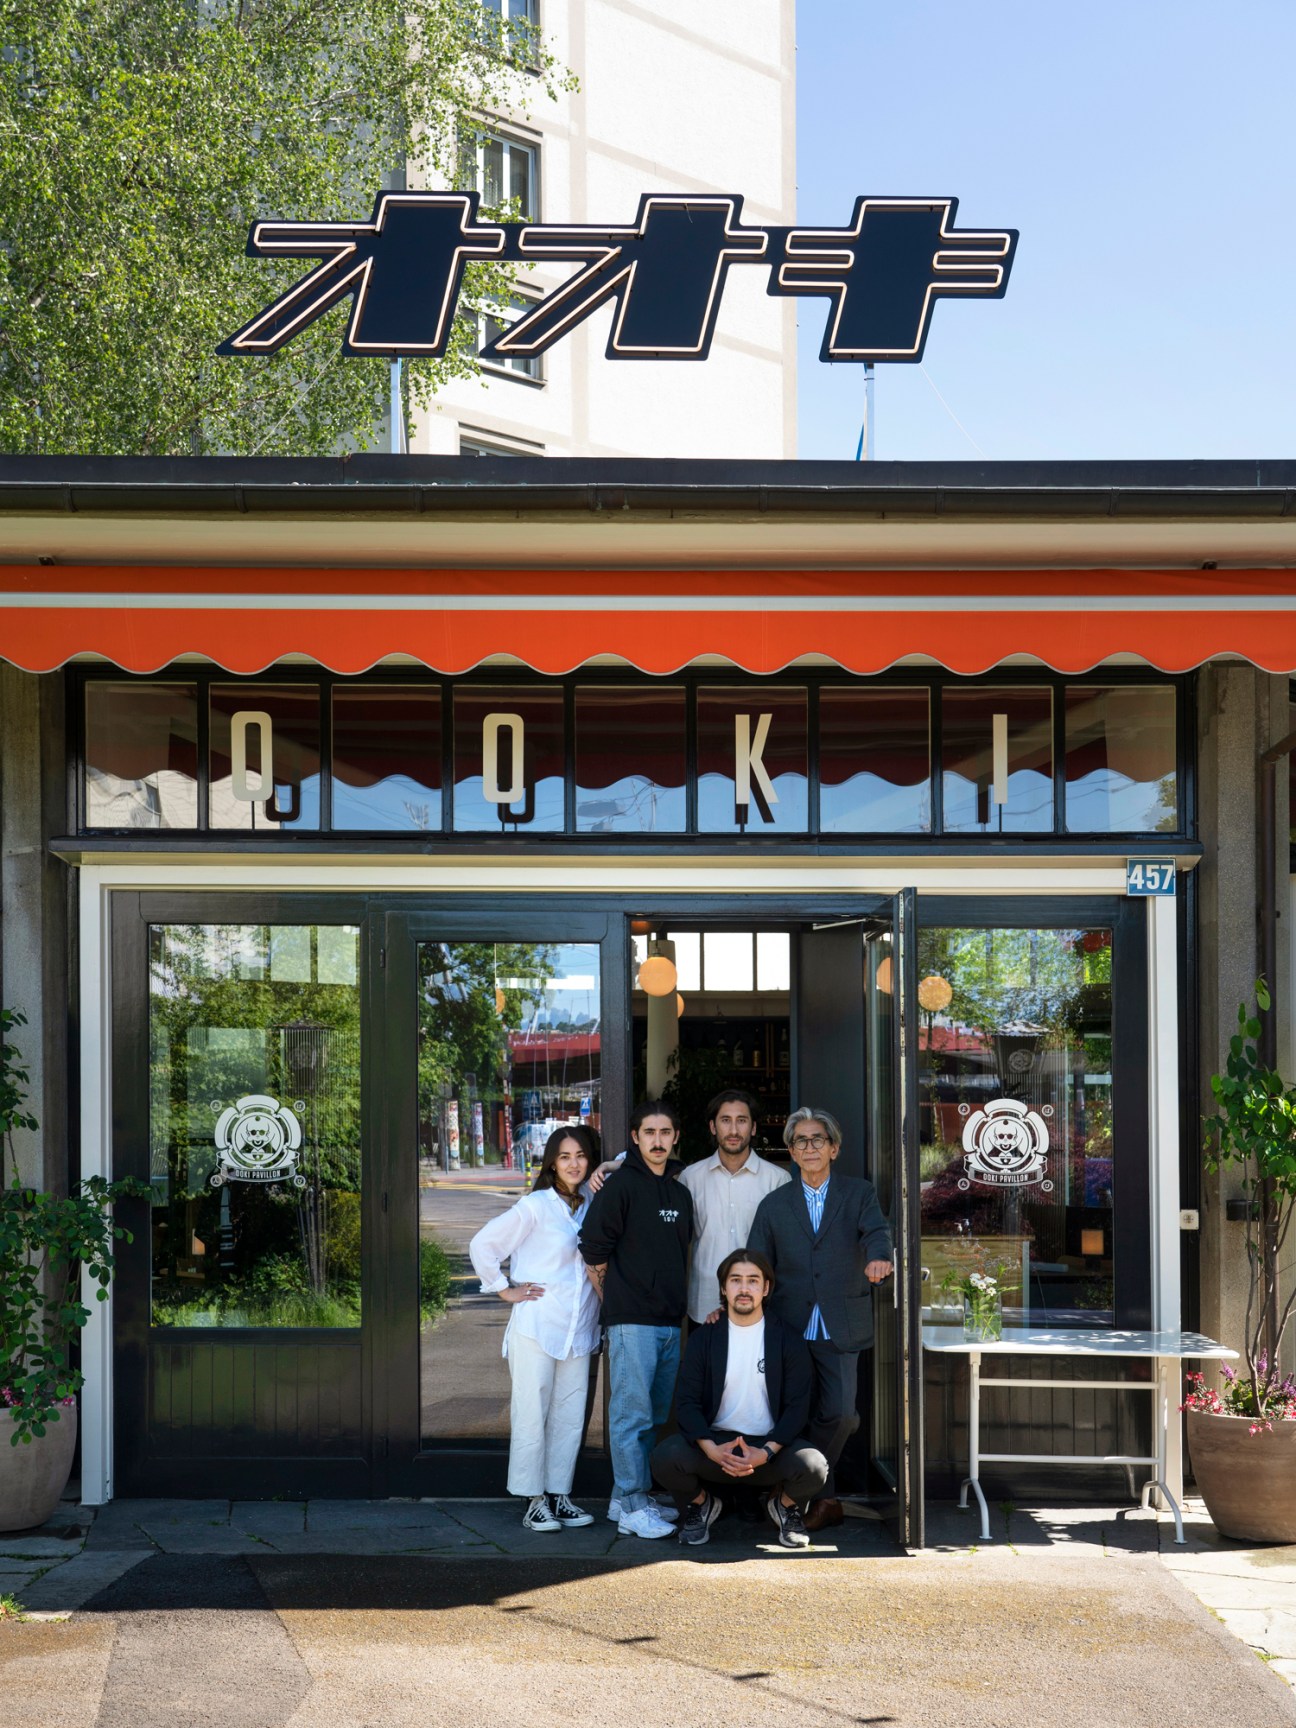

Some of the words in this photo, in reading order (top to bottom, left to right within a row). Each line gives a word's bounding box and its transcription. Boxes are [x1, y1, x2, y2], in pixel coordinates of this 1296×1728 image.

[214, 190, 1020, 364] オオキ
[1129, 864, 1174, 890] 457
[235, 1169, 250, 1179] OOKI
[252, 1169, 281, 1179] PAVILLON
[982, 1173, 998, 1182] OOKI
[999, 1173, 1029, 1183] PAVILLON
